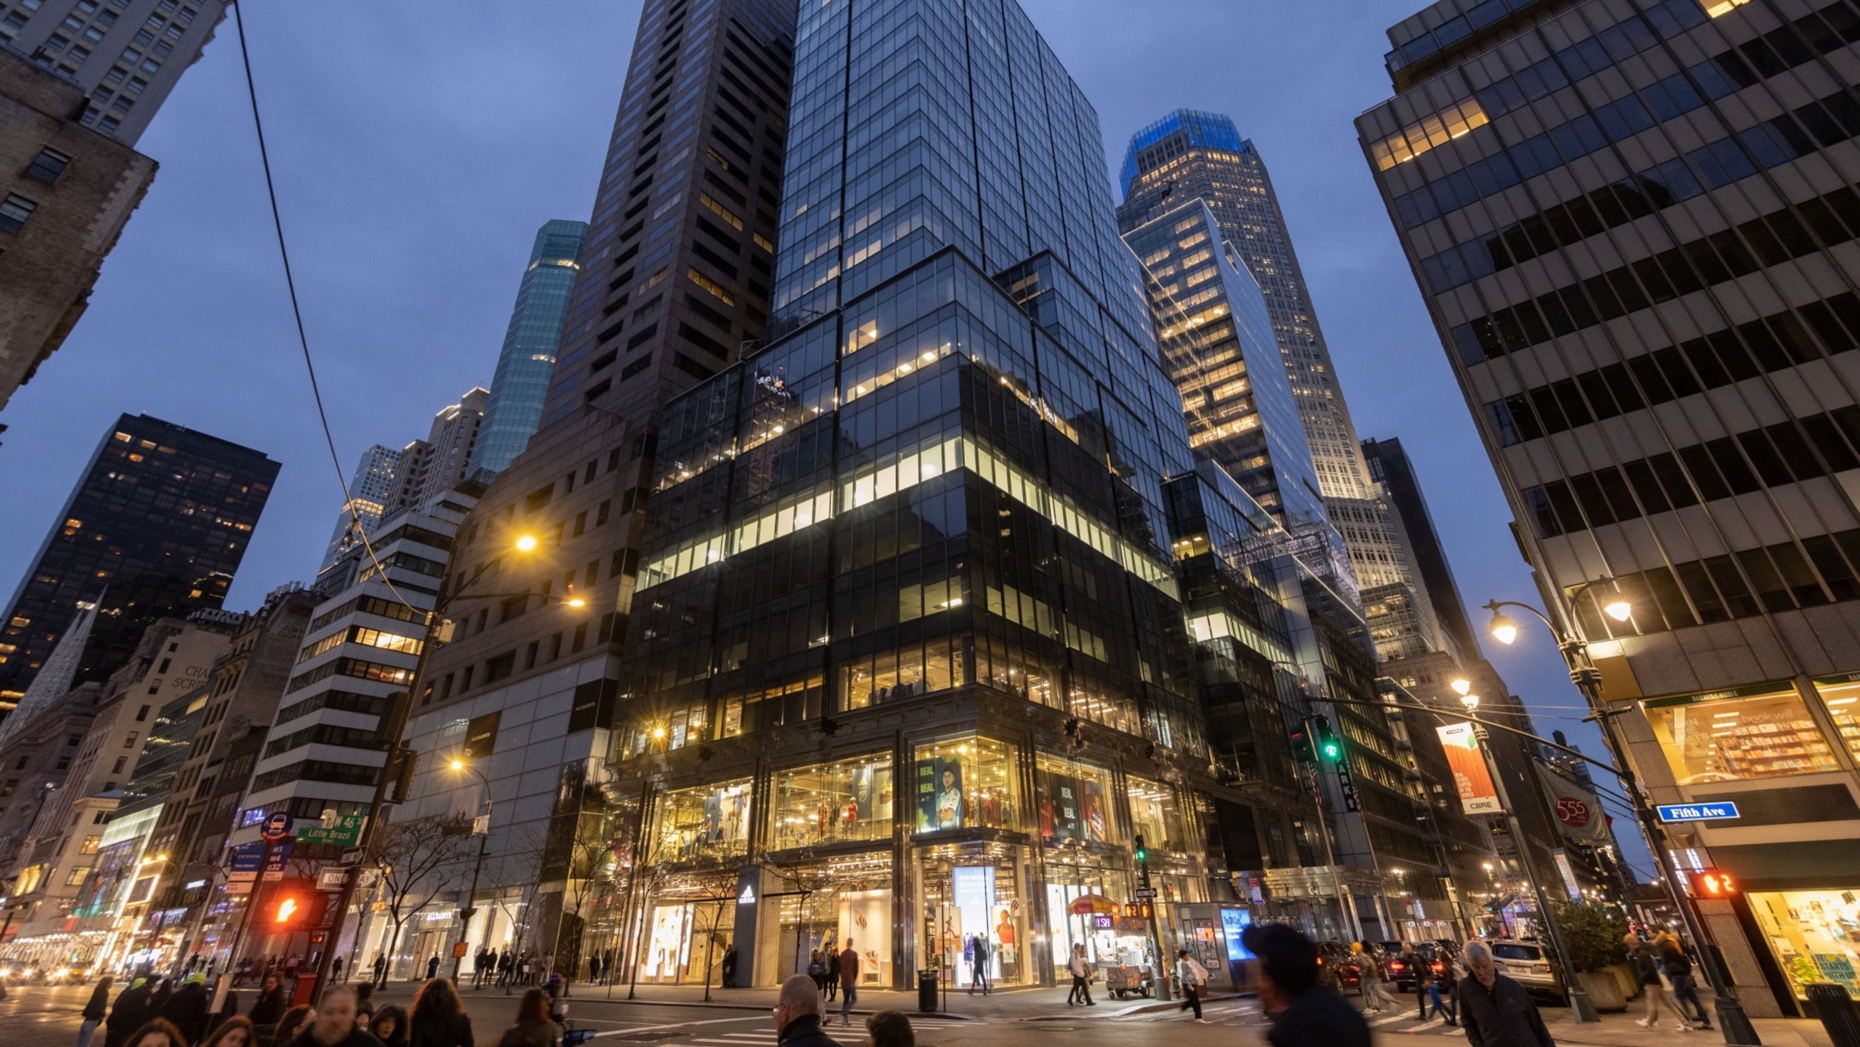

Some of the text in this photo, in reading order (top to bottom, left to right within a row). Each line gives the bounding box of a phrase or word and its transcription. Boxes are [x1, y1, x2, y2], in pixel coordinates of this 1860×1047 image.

[185, 665, 208, 679] CHA
[1742, 711, 1771, 723] book
[1773, 708, 1794, 720] will
[920, 766, 934, 776] REAL
[920, 783, 935, 793] REAL
[1061, 787, 1073, 799] REAL
[1470, 801, 1492, 810] CBRE
[1557, 800, 1585, 821] 555
[1063, 807, 1075, 819] REAL
[1670, 807, 1726, 818] Fifth Ave
[334, 815, 343, 827] W
[343, 817, 356, 829] 46
[308, 828, 351, 840] Little Brazil
[328, 874, 348, 883] ONE
[1720, 874, 1734, 891] 2
[1820, 962, 1850, 970] STARTS
